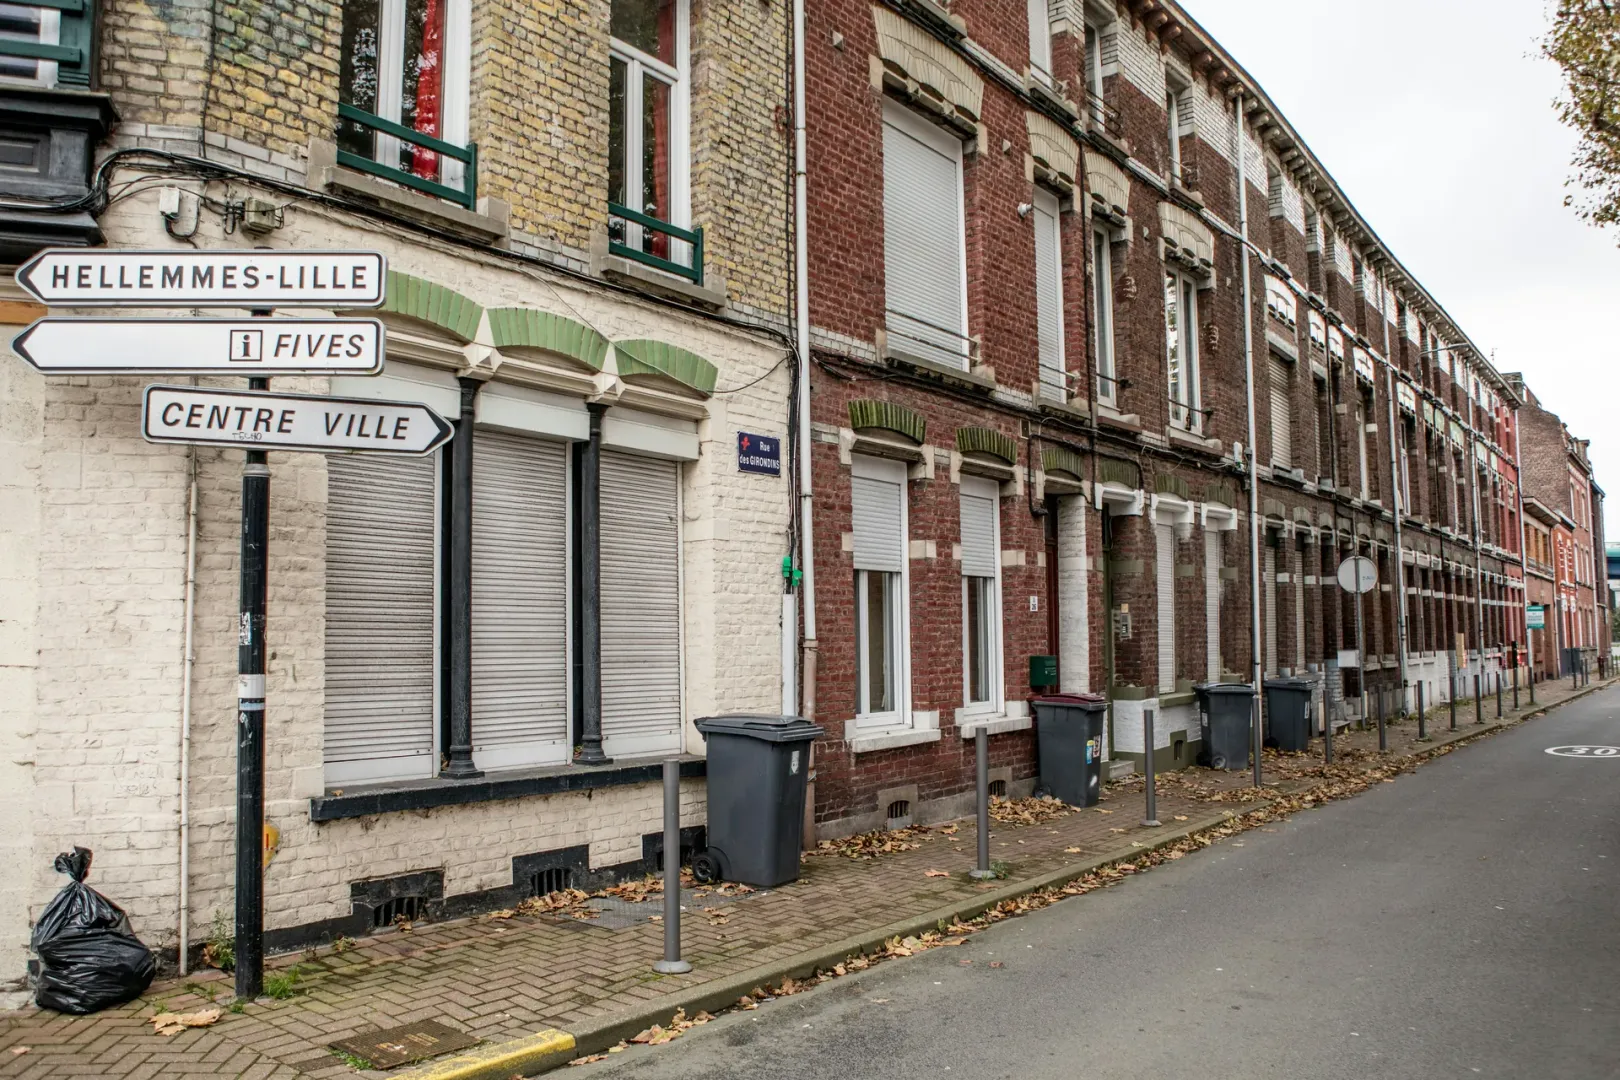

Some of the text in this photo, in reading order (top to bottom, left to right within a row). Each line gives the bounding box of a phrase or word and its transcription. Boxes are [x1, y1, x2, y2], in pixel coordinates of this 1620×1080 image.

[51, 264, 368, 291] HELLEMMES-LILLE
[273, 334, 365, 359] FIVES
[161, 402, 410, 441] CENTRE VILLE
[760, 441, 770, 452] Rue
[740, 454, 779, 469] des GIRONDINS
[1564, 747, 1617, 755] 30
